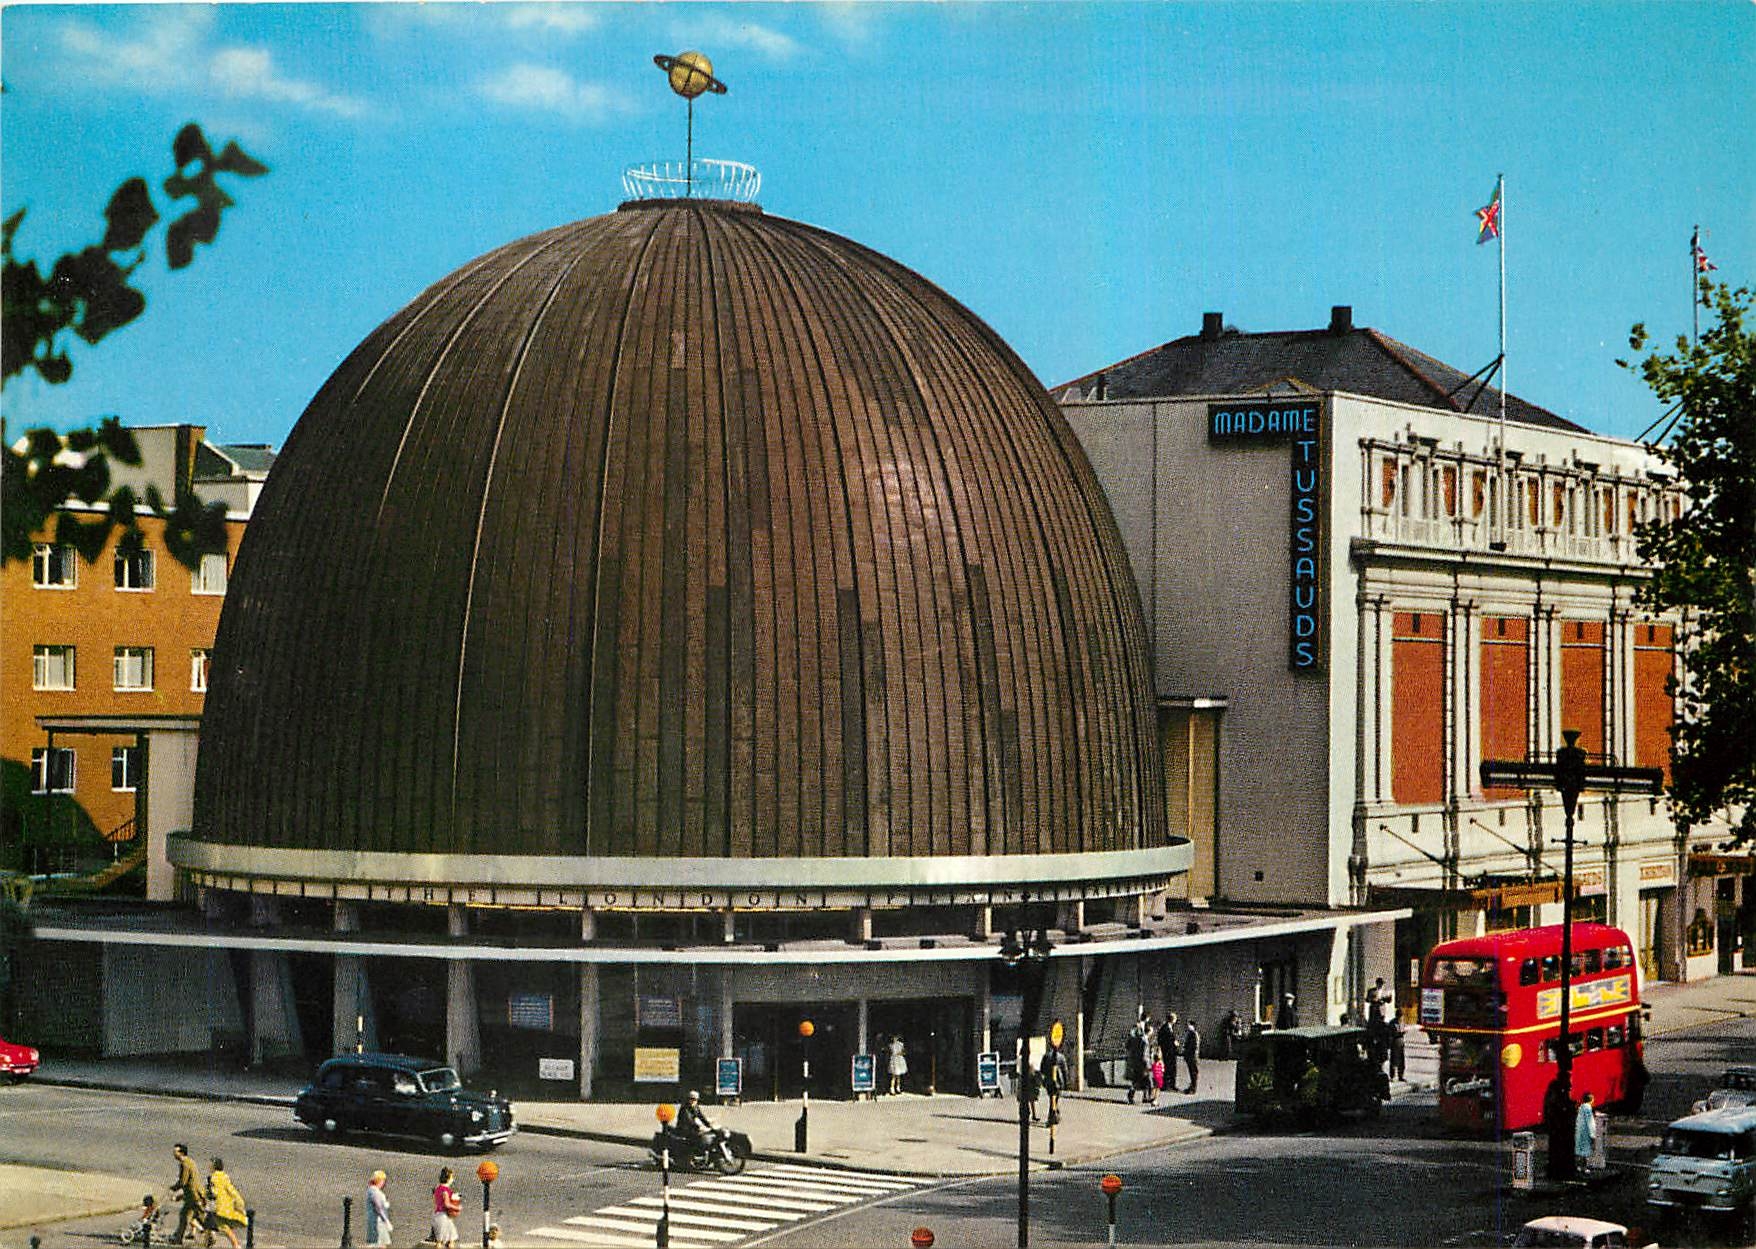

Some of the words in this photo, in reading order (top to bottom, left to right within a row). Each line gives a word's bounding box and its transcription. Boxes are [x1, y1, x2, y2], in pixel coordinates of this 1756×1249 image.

[1214, 409, 1317, 434] MADAME
[1296, 440, 1316, 666] TUSSAUDS
[384, 886, 476, 902] THE
[560, 890, 807, 906] LONDON
